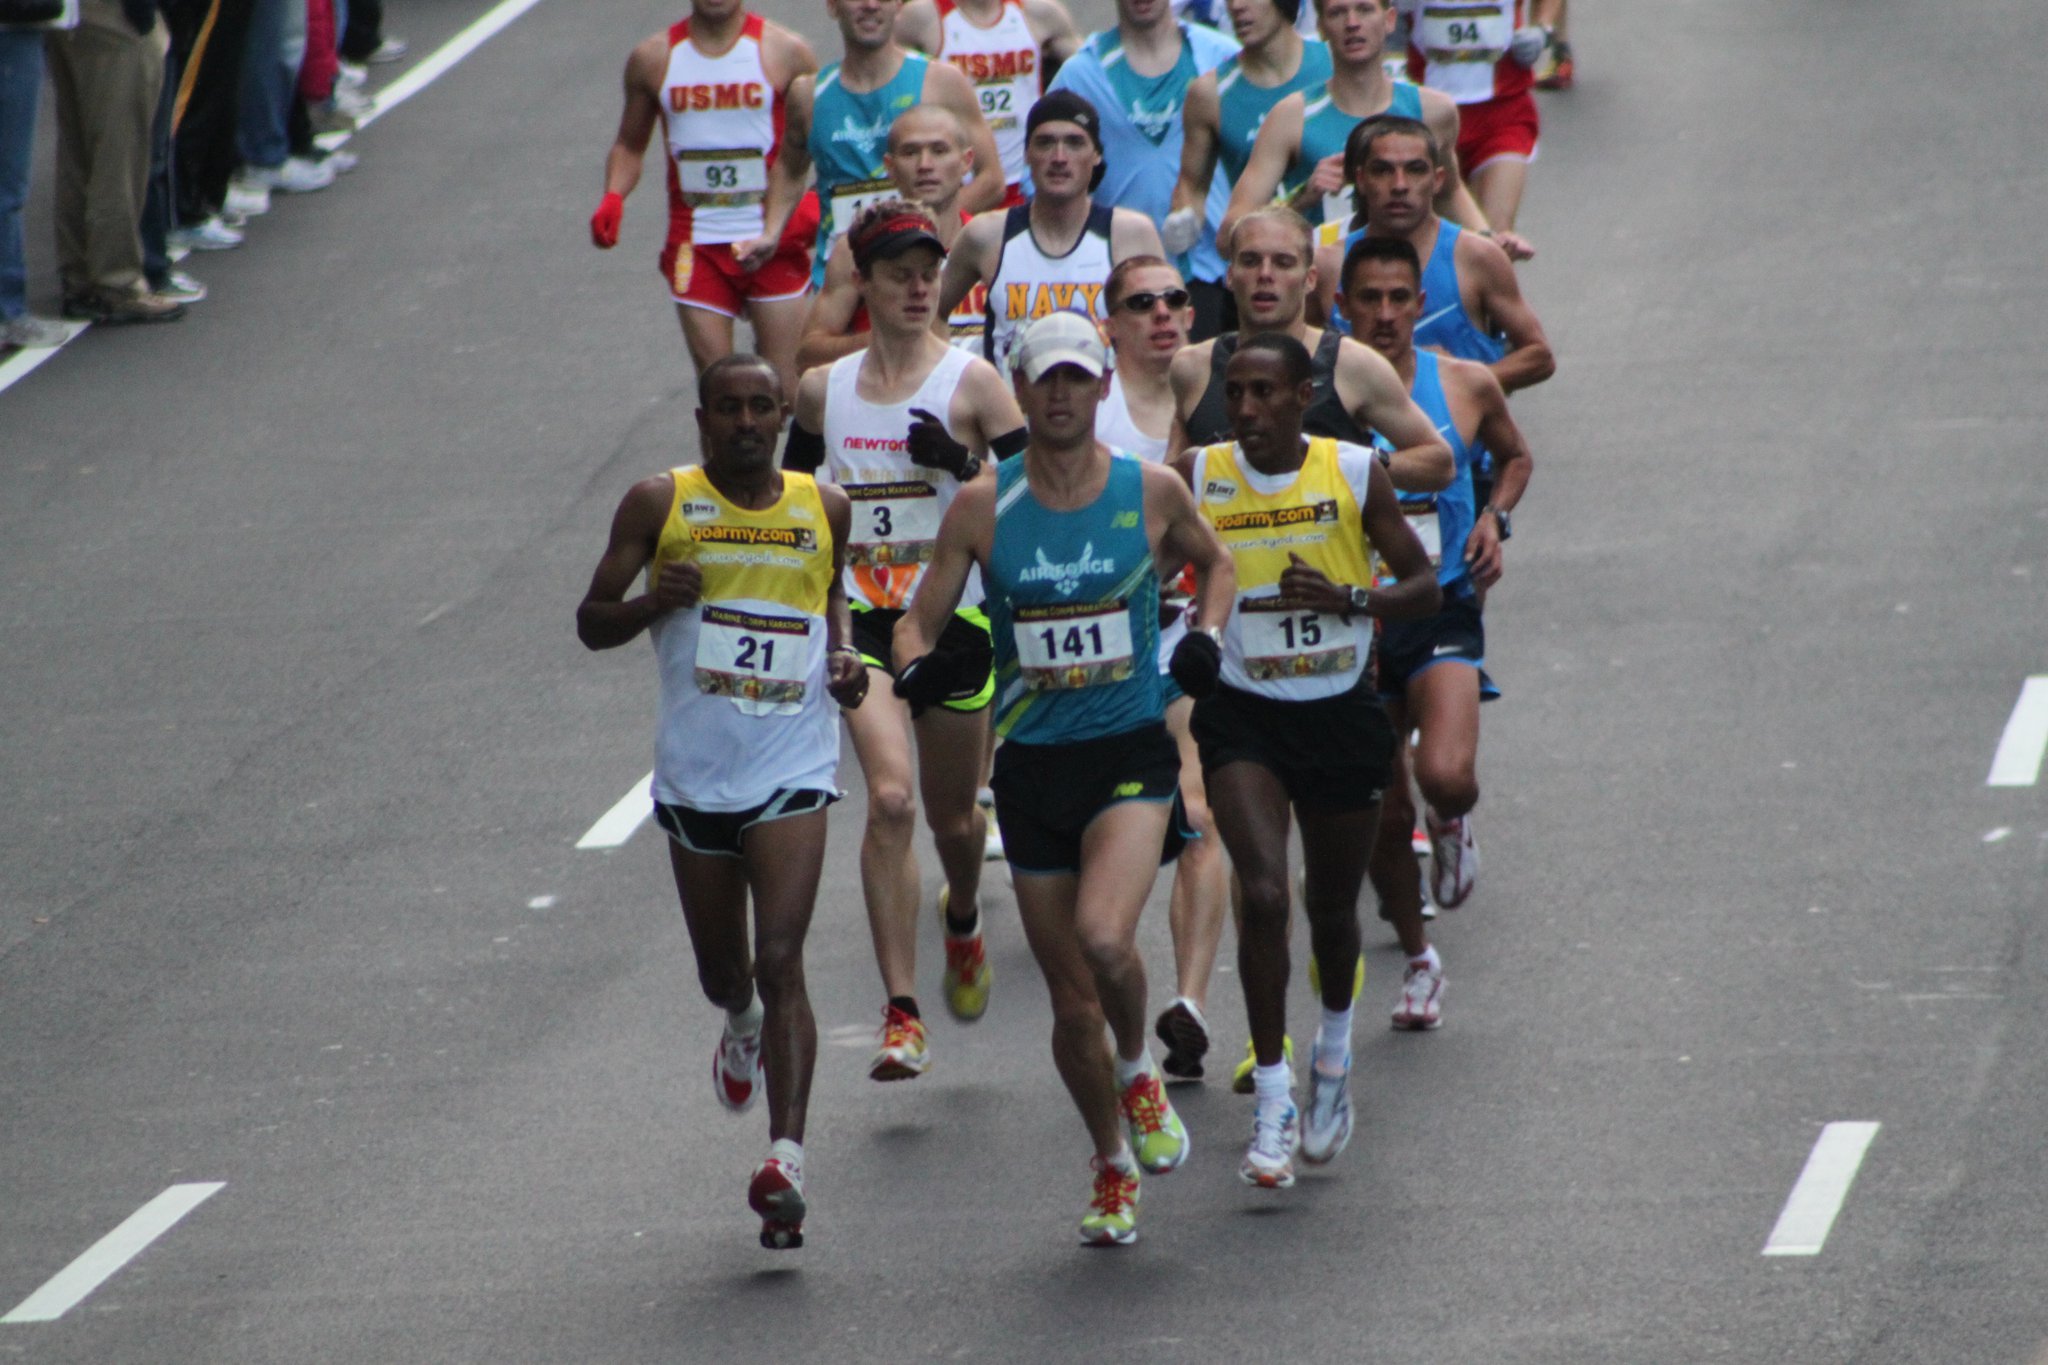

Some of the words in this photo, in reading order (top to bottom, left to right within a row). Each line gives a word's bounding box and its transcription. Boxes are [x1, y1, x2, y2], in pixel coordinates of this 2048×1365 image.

[1448, 22, 1478, 43] 94
[669, 82, 763, 113] USMC
[981, 89, 1012, 113] 92
[706, 165, 738, 188] 93
[1006, 283, 1103, 320] NAVY
[873, 506, 893, 537] 3
[1214, 506, 1315, 532] goarmy.com
[690, 525, 797, 545] goarmy.com
[1040, 622, 1103, 660] 141
[1278, 613, 1321, 649] 15
[734, 635, 775, 672] 21
